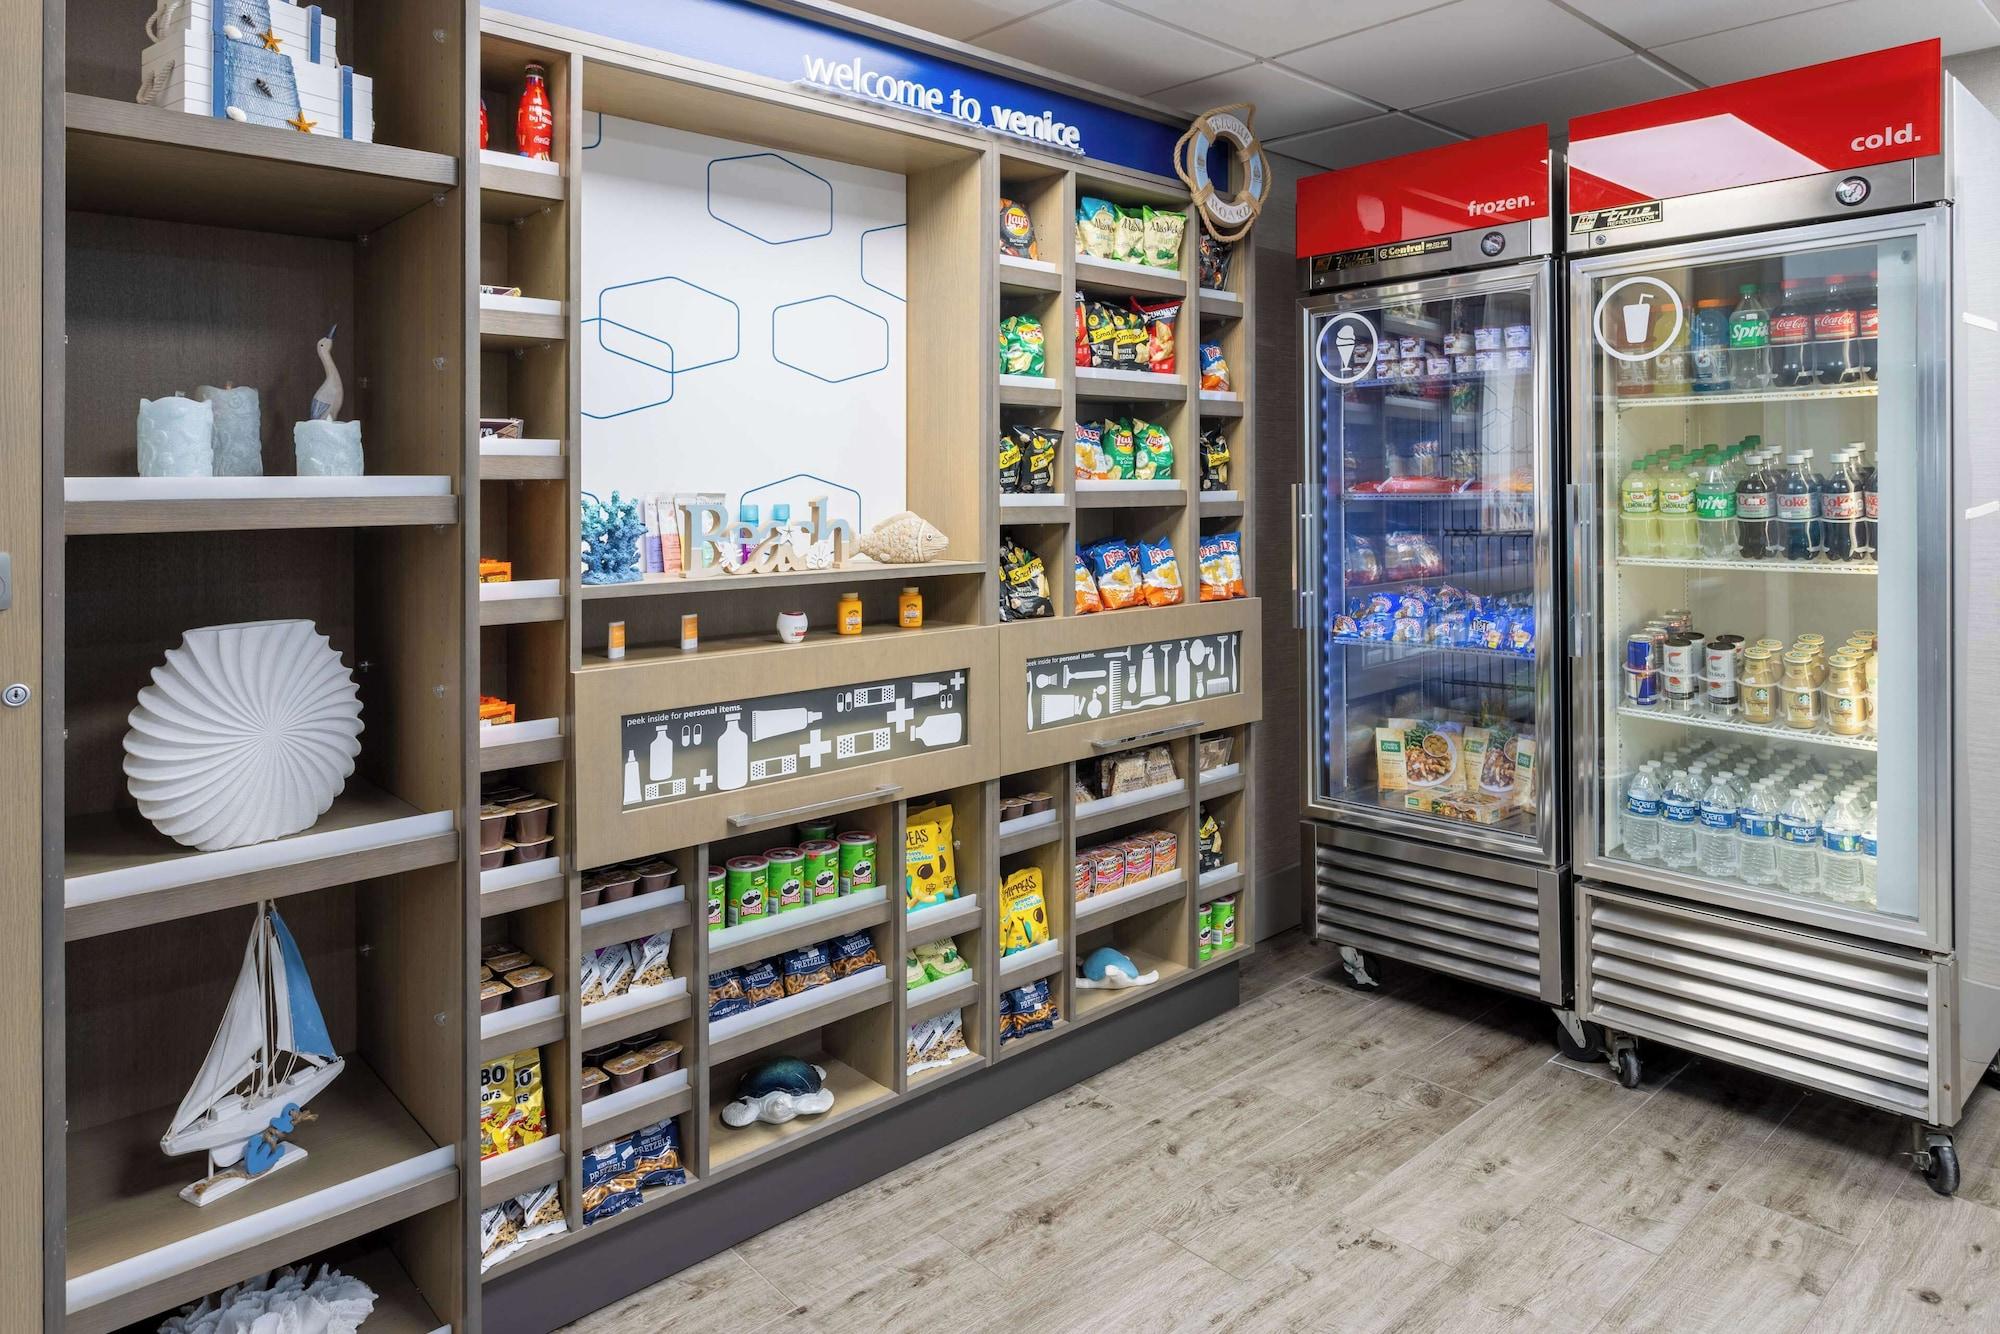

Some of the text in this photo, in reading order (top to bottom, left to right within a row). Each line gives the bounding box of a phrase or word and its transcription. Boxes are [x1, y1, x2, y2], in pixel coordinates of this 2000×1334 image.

[802, 54, 1082, 149] welcome to venice
[1850, 123, 1921, 152] cold.
[1209, 198, 1250, 221] BOARD
[1467, 195, 1535, 216] frozen.
[1388, 241, 1425, 256] Central
[1059, 654, 1080, 664] personal
[627, 704, 742, 727] peek inside for personal items.
[1629, 798, 1656, 809] niagara
[1666, 805, 1694, 817] niagara
[793, 954, 826, 970] PRETZELS
[746, 970, 774, 984] PRETZELS
[634, 1135, 671, 1155] PRETZELS
[589, 1160, 627, 1182] PRETZELS
